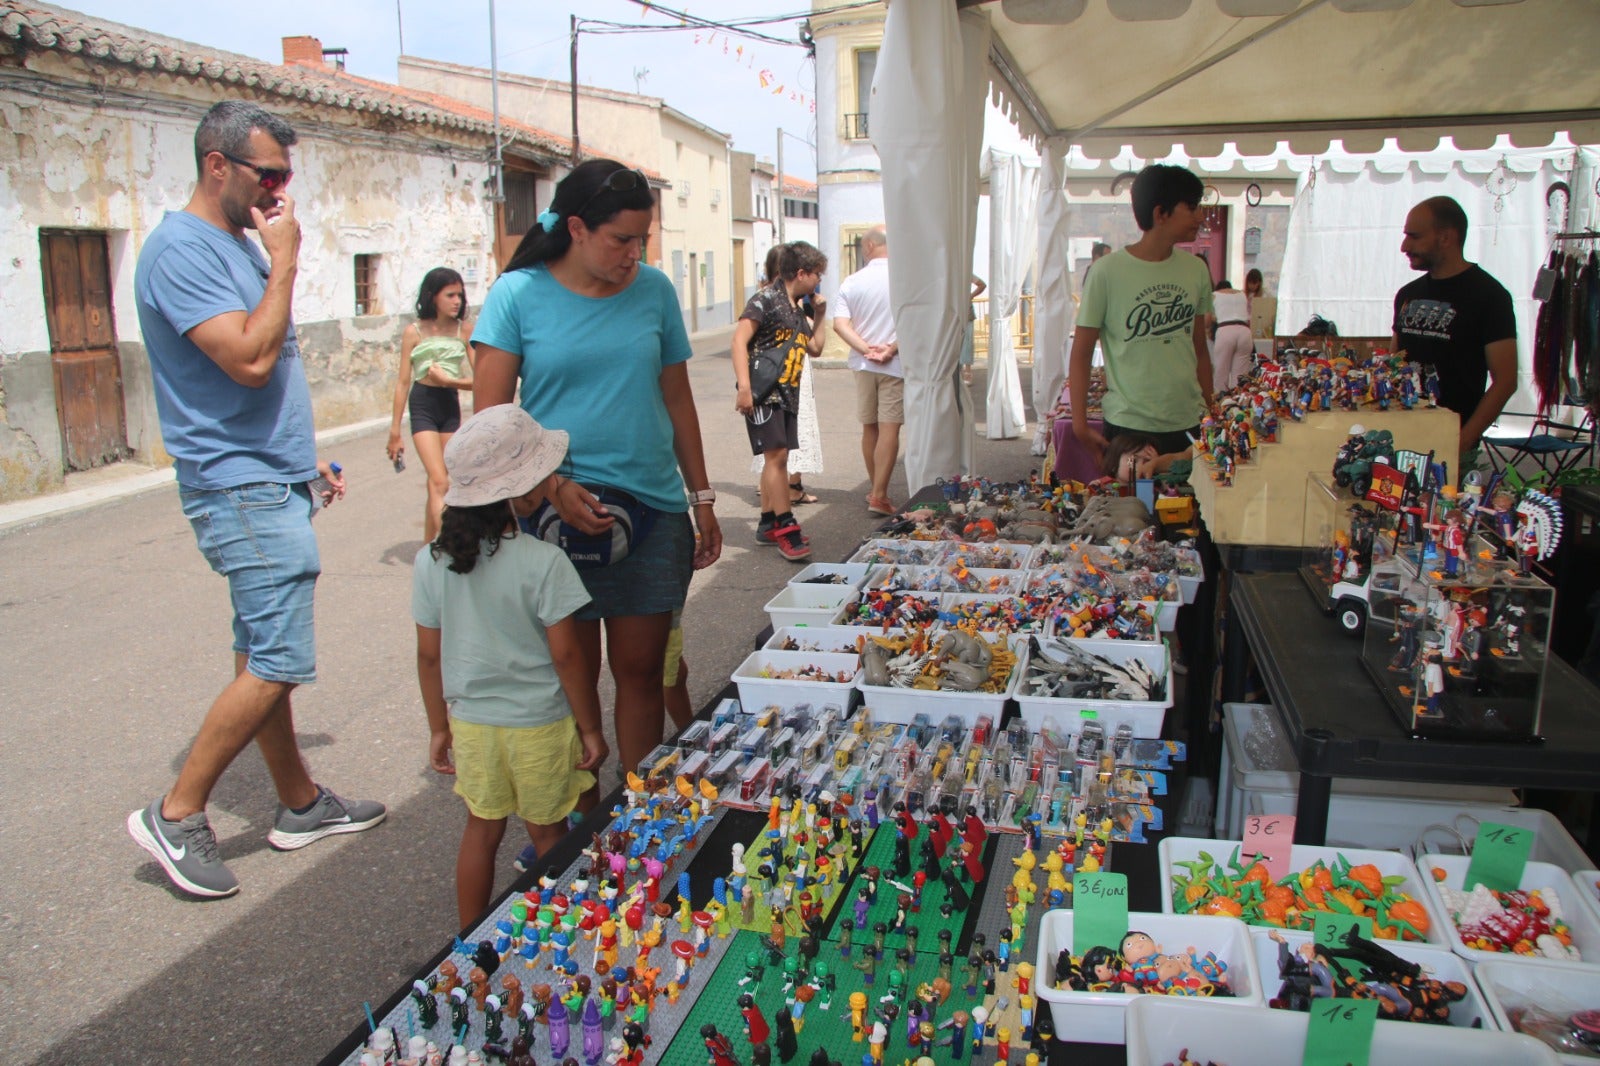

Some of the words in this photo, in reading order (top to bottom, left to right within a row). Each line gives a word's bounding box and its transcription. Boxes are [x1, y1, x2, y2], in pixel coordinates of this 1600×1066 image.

[1124, 295, 1195, 342] Boston
[1249, 817, 1280, 835] 3€
[1485, 828, 1520, 845] 1€
[1322, 1004, 1357, 1023] 1€
